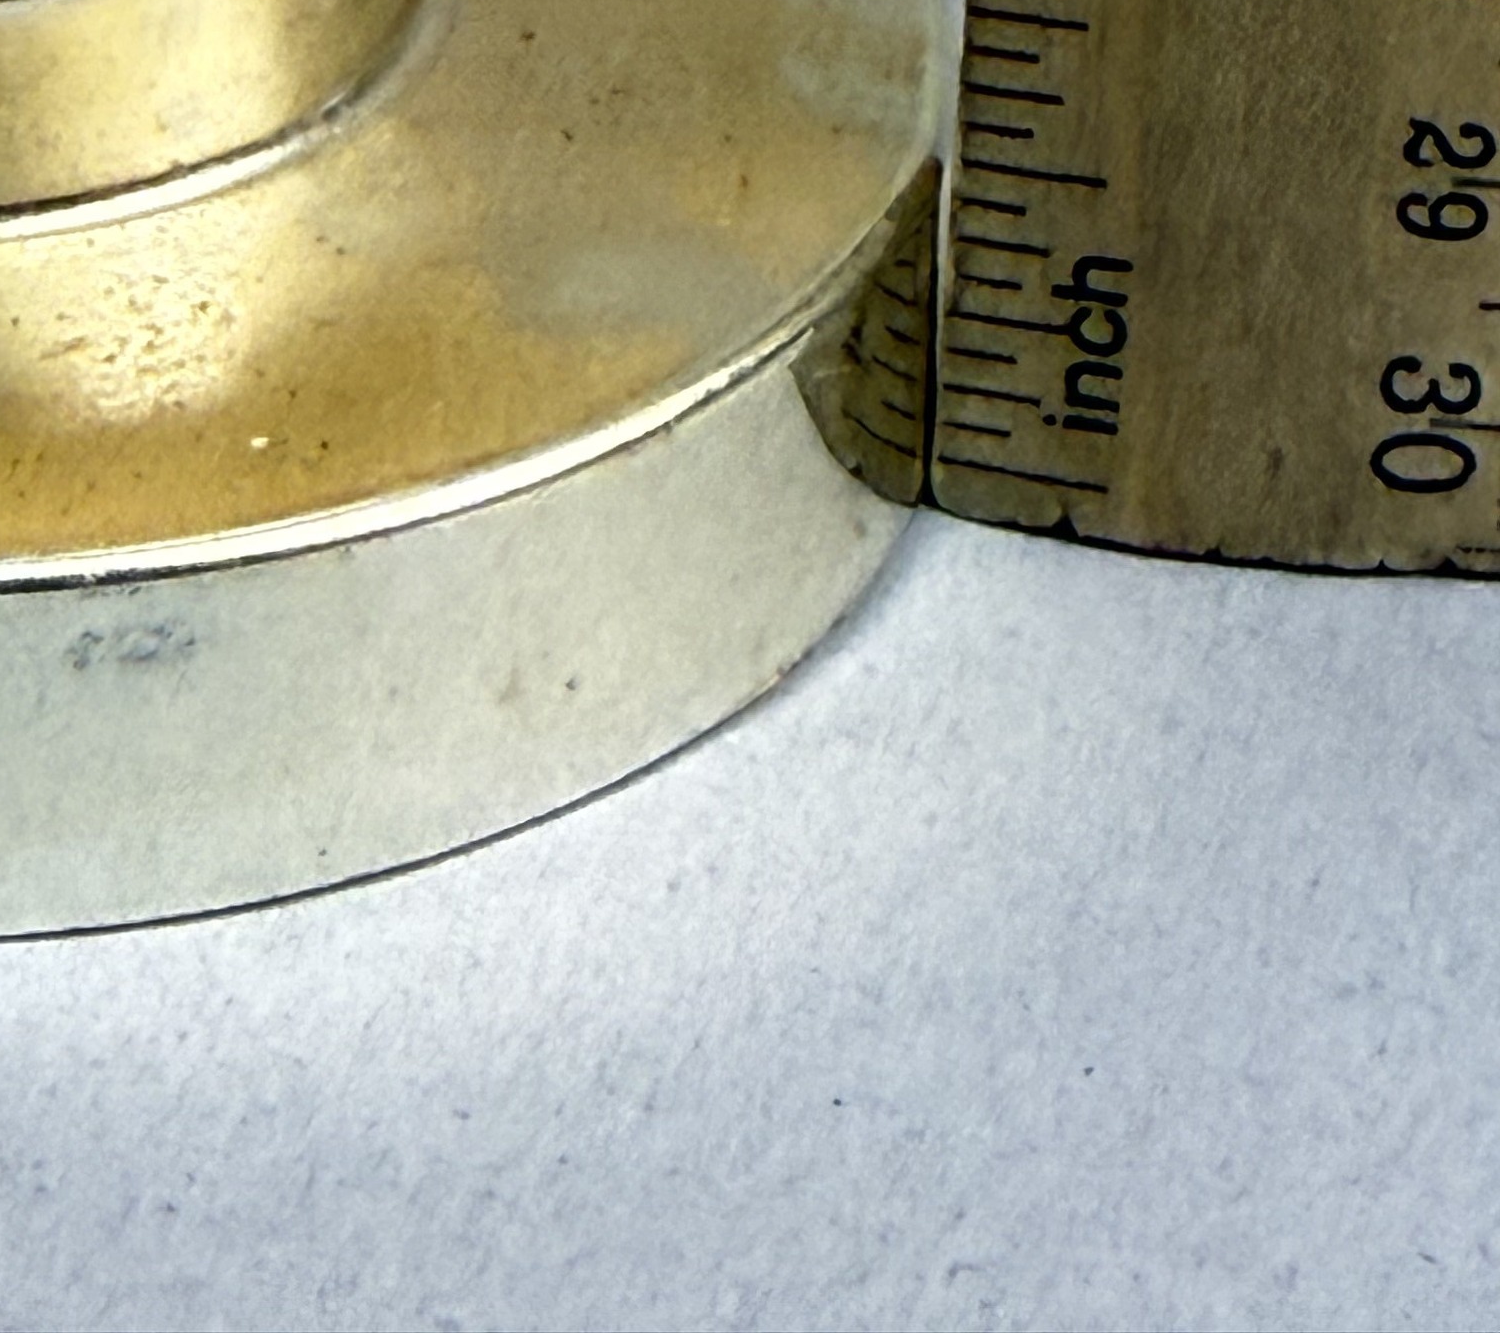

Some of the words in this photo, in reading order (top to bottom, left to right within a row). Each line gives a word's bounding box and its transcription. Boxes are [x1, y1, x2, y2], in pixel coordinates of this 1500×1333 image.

[1395, 116, 1496, 241] 29
[1041, 254, 1134, 435] inch
[1369, 354, 1482, 494] 30
